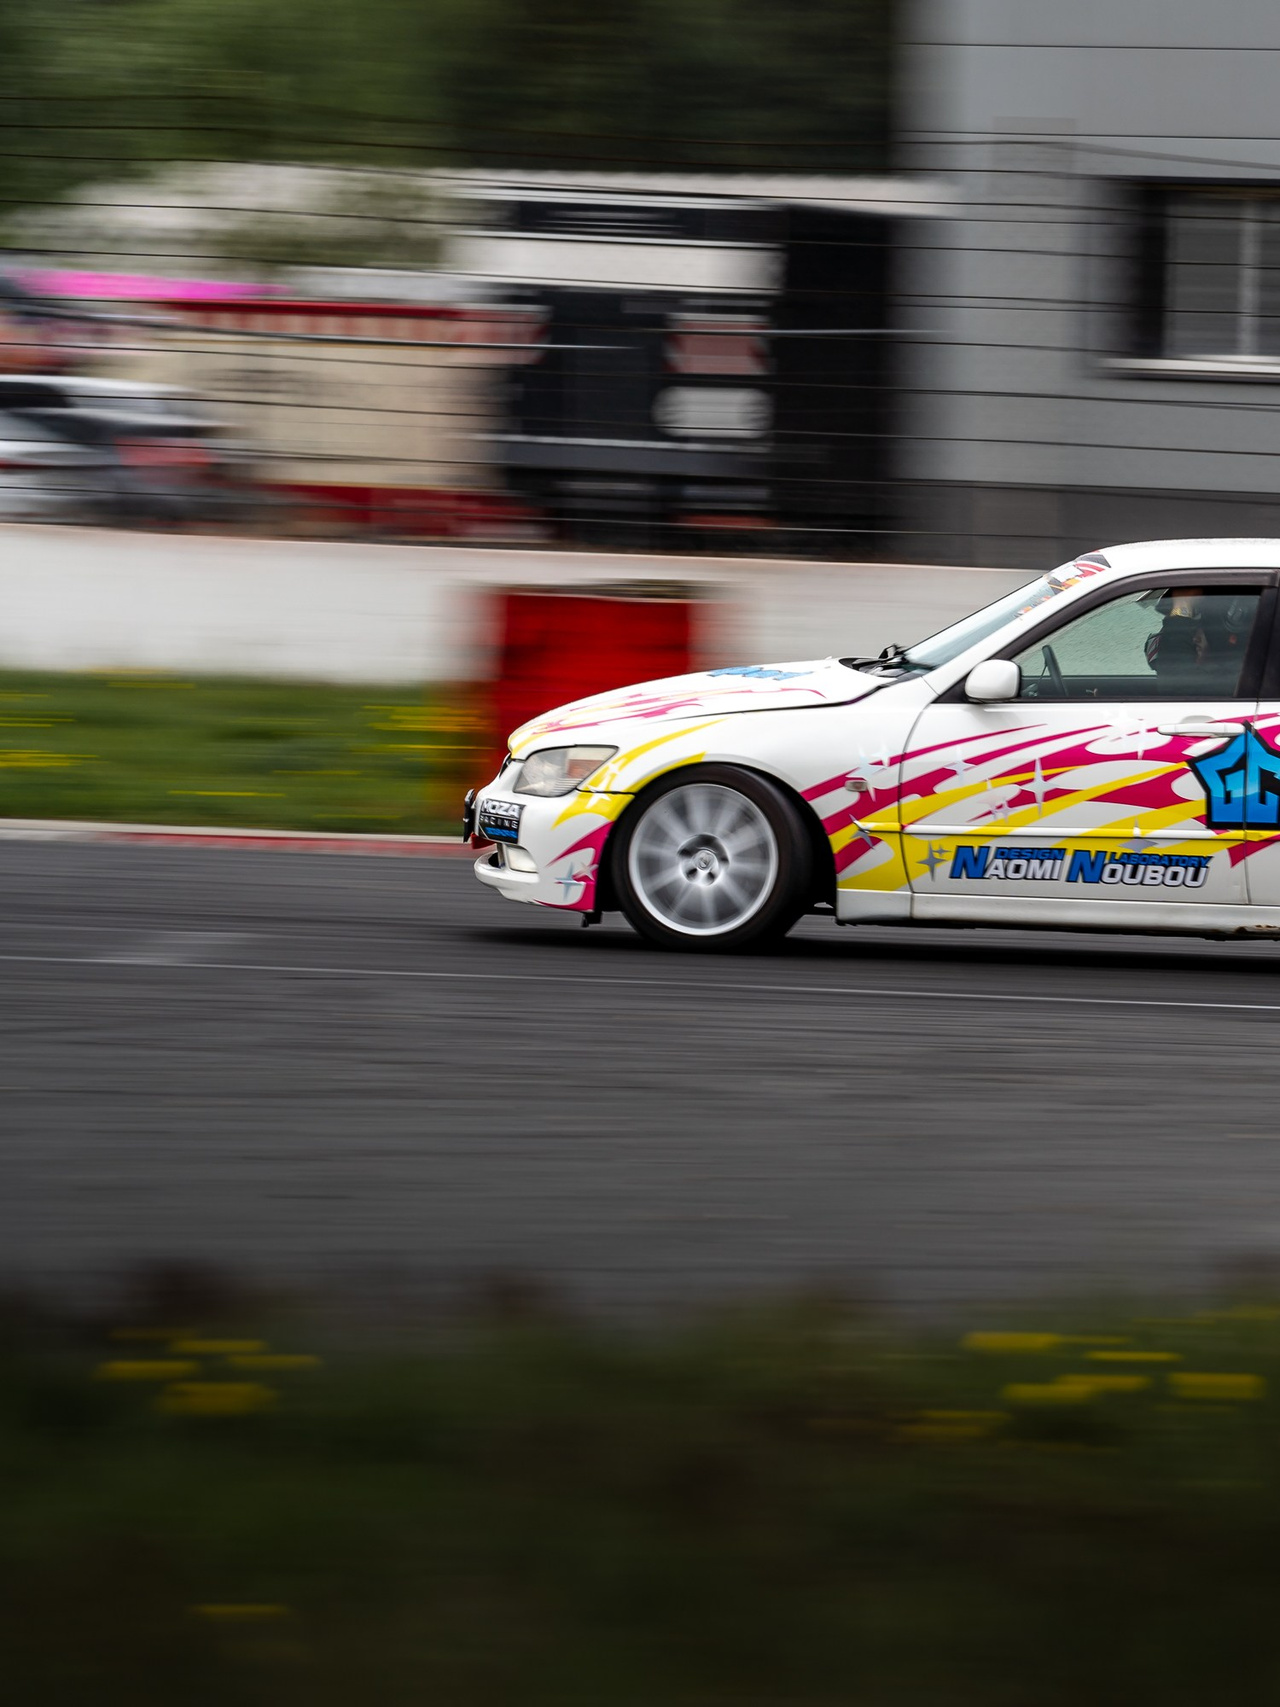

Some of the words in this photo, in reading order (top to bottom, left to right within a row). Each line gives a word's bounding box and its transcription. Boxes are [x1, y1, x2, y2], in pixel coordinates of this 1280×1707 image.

[480, 799, 521, 819] MOZA
[949, 845, 1061, 881] NAOMI
[1065, 849, 1208, 888] NOUBOU
[994, 847, 1067, 861] DESIGN
[1108, 851, 1214, 868] LABORATORY
